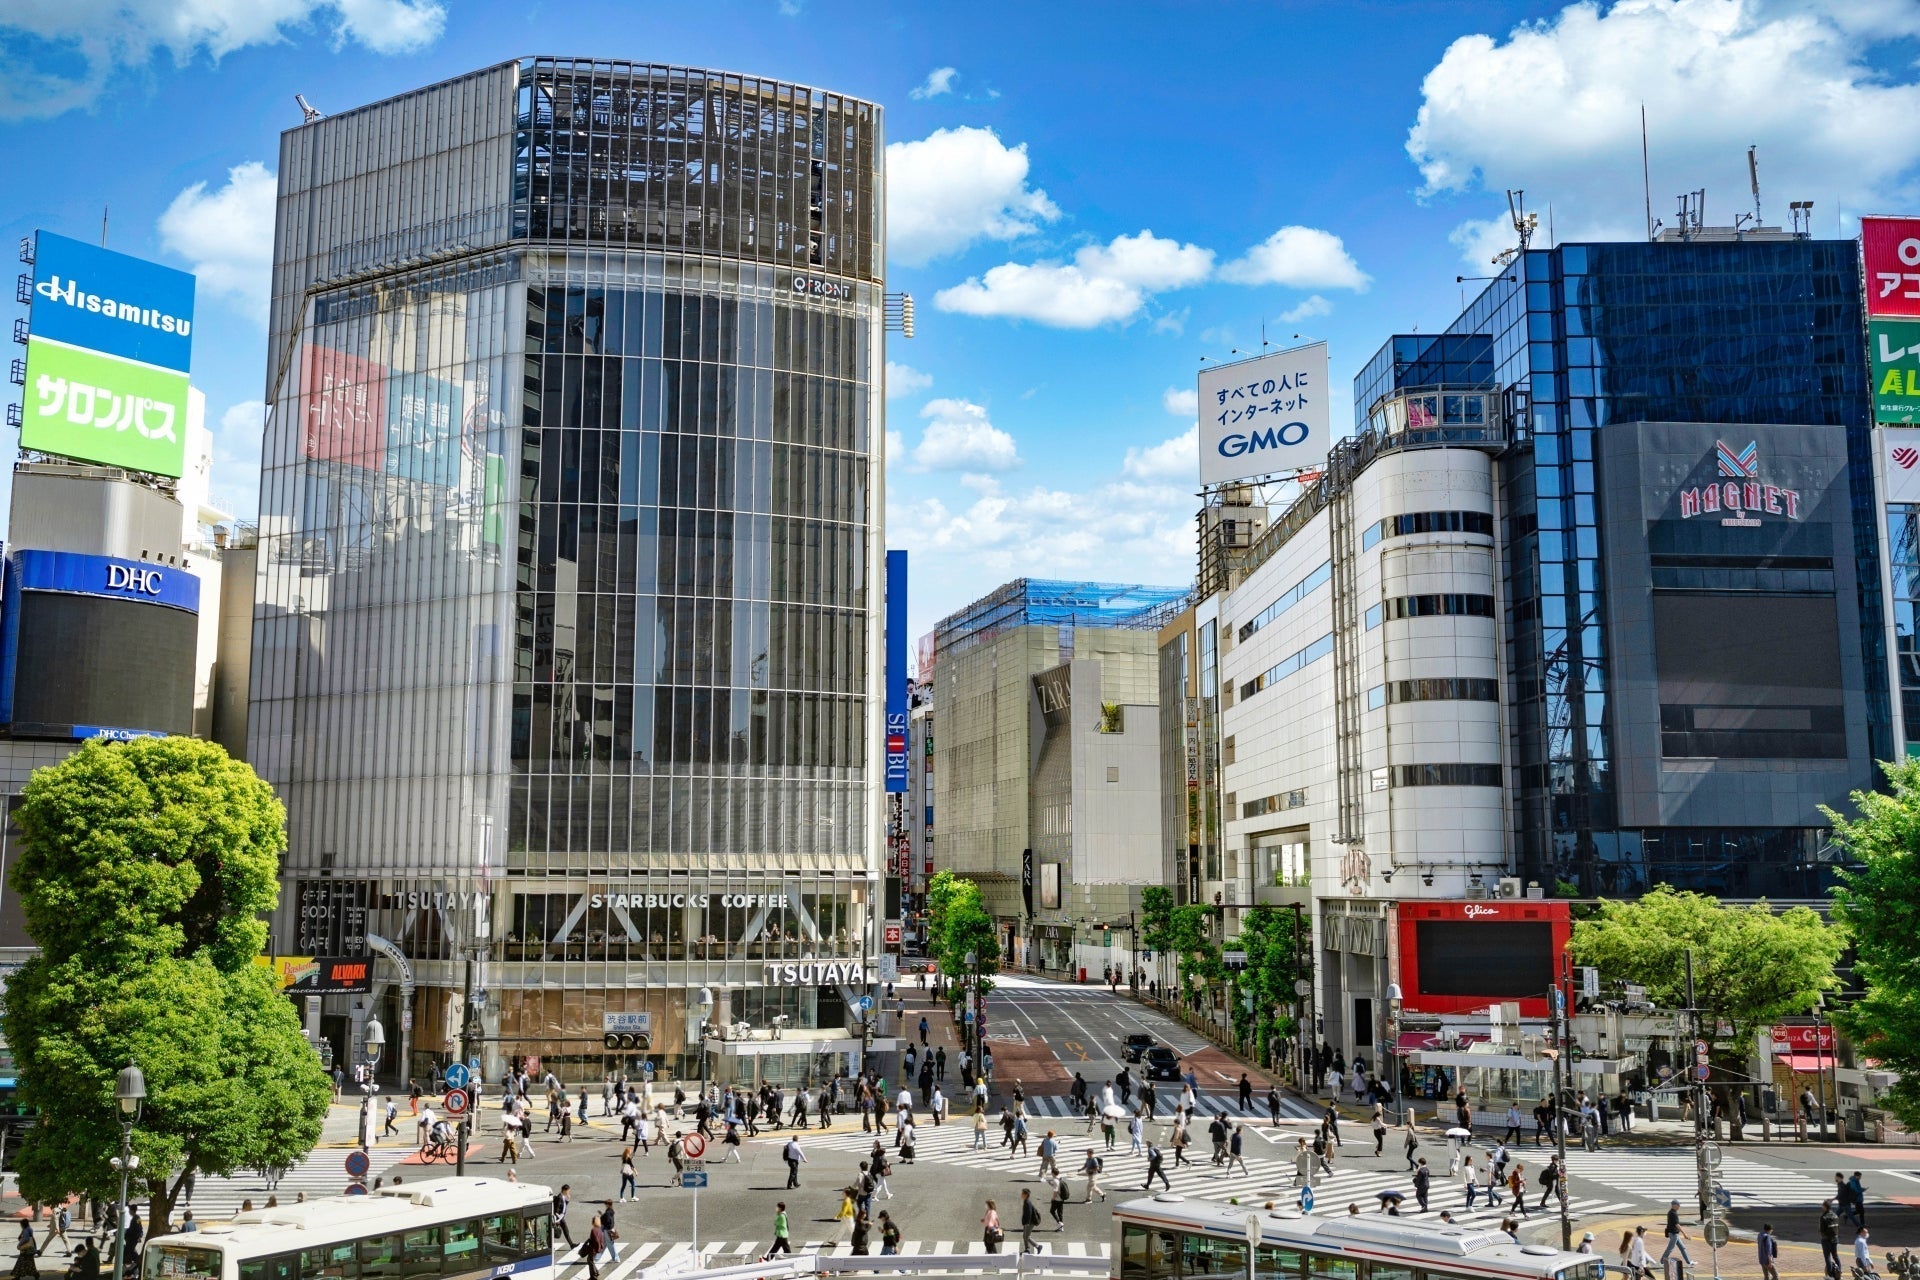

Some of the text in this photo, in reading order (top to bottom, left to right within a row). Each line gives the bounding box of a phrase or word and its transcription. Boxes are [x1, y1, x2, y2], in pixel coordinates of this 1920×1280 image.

[36, 275, 191, 337] Hisamitsu
[1216, 372, 1308, 406] すべての人に
[36, 374, 177, 444] サロンパス
[1217, 393, 1308, 426] インターネット
[1218, 422, 1309, 458] GMO
[1680, 482, 1799, 519] MAGNET
[107, 564, 163, 595] DHC
[99, 729, 119, 739] DHC
[395, 891, 483, 910] TSUTAYA
[590, 894, 788, 909] STARBUCKS COFFEE
[1464, 904, 1500, 919] Glico
[887, 929, 900, 941] 本
[1045, 926, 1059, 939] ZARA
[331, 964, 367, 980] ALVARK
[770, 963, 864, 983] TSUTAYA
[607, 1014, 647, 1024] 渋谷駅前
[1802, 1029, 1830, 1047] Cy
